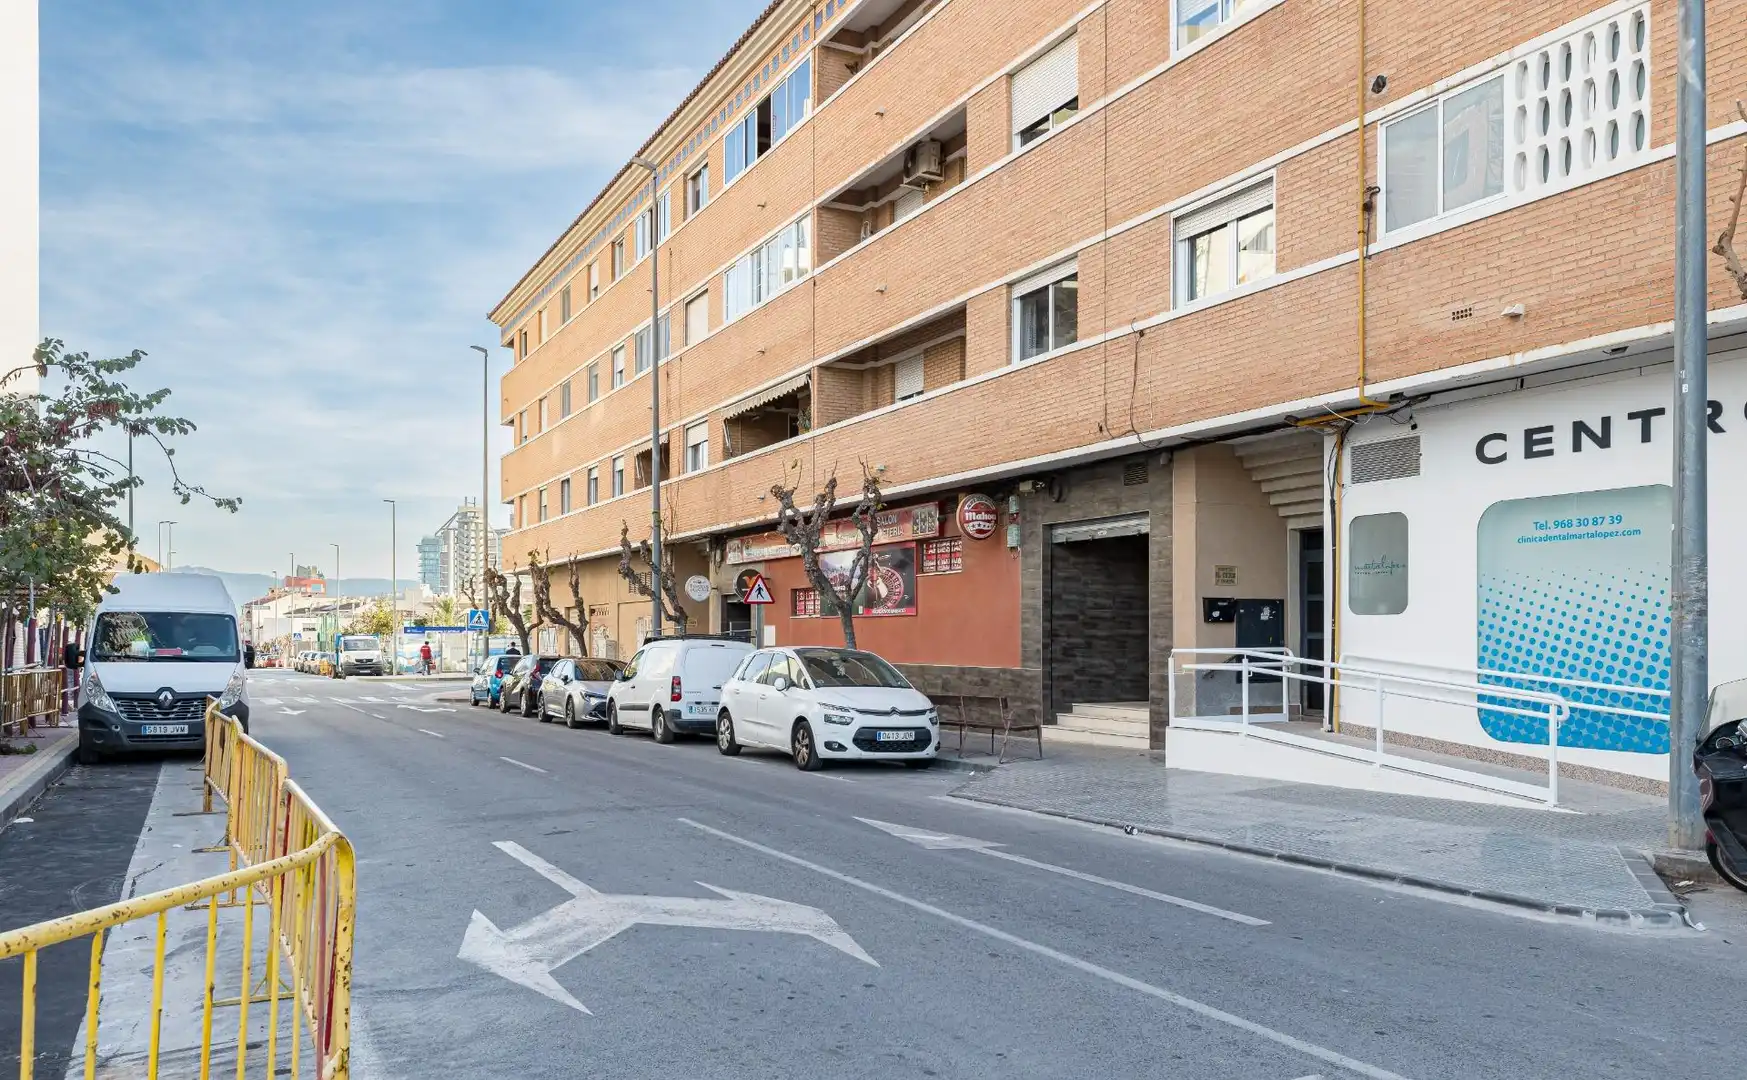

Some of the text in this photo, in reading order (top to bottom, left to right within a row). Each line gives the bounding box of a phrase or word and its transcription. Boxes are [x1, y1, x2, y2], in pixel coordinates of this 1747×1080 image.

[1475, 400, 1747, 465] CENTR
[965, 511, 997, 521] Mahou
[1533, 514, 1623, 531] Tel. 968 30 87 39
[1517, 528, 1642, 544] clinicadentalmartalopez.com
[147, 726, 168, 734] 5819
[882, 732, 900, 740] 0413
